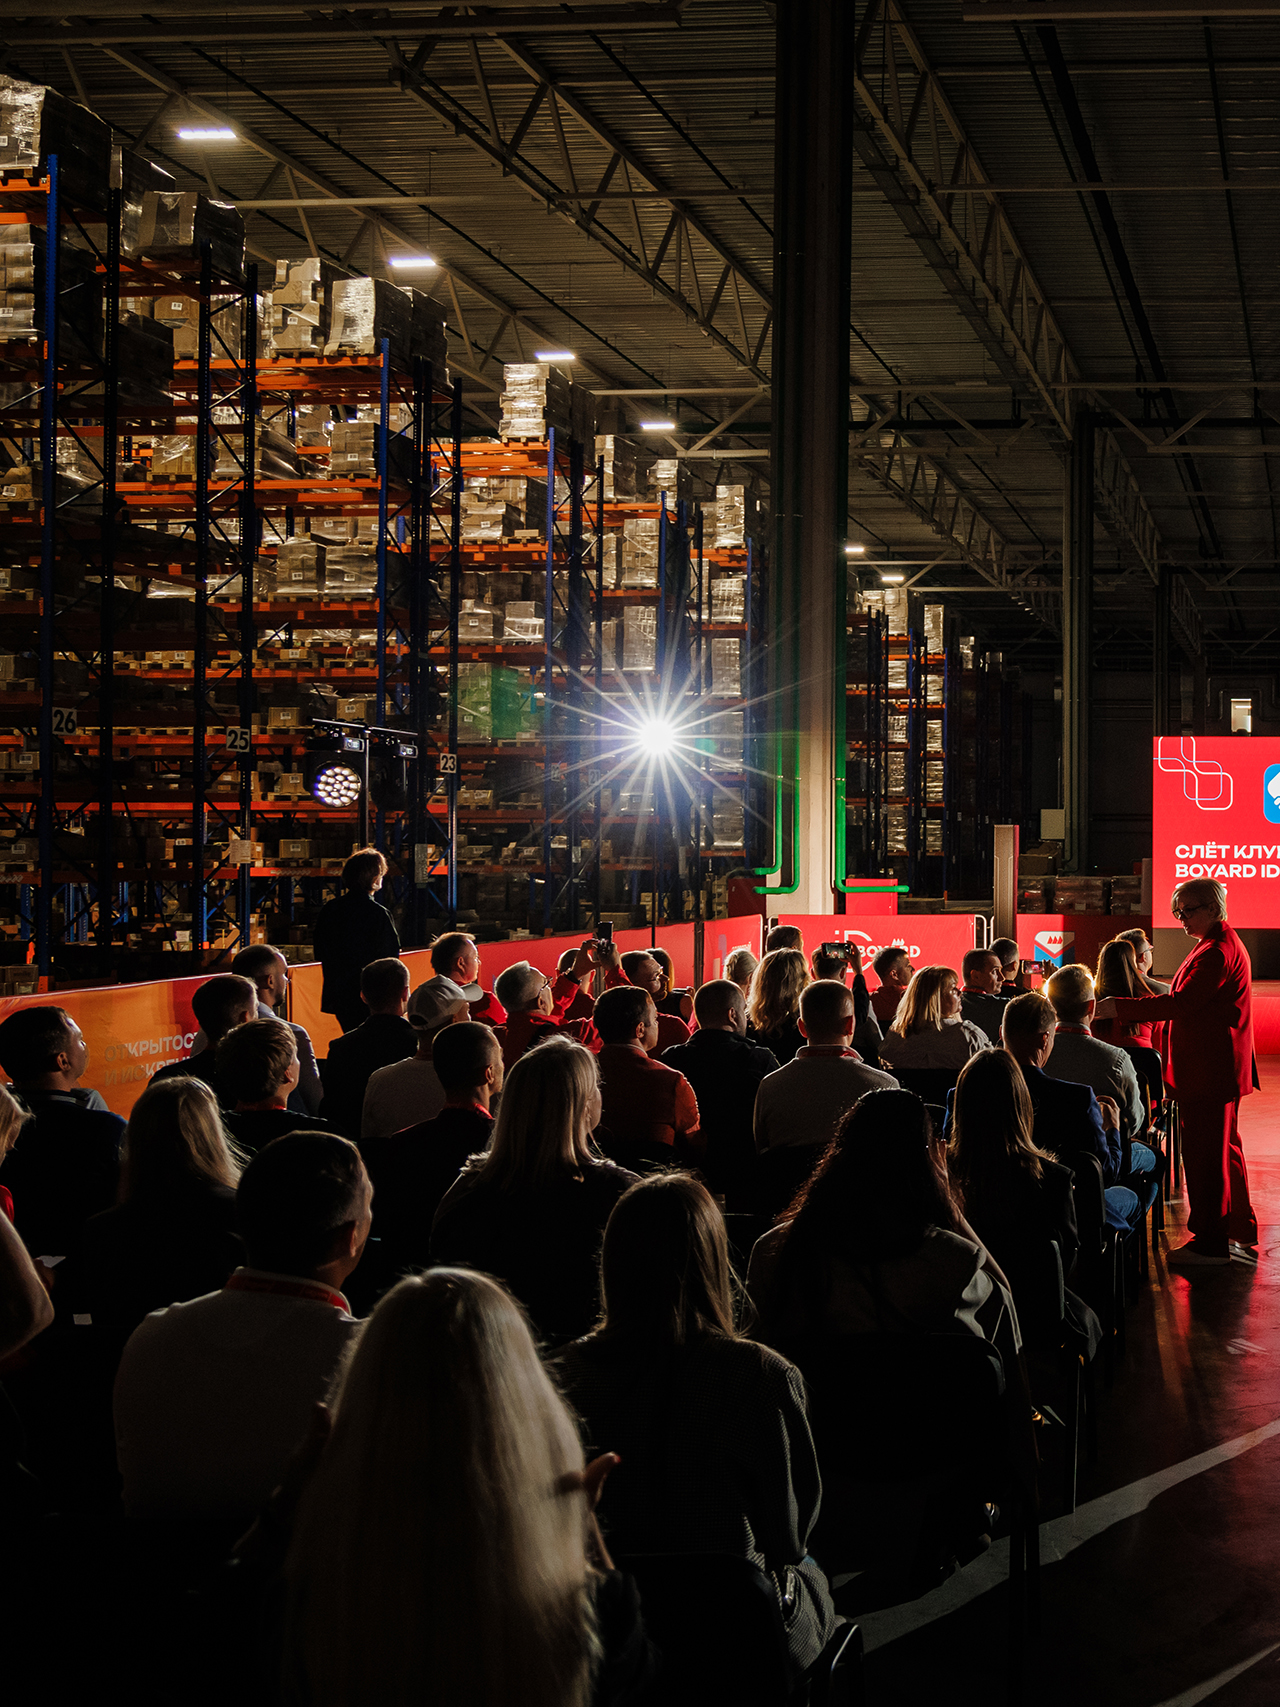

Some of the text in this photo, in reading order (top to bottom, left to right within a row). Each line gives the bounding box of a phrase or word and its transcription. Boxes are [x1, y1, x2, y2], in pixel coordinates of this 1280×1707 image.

[53, 709, 77, 733] 26
[227, 729, 249, 750] 25
[441, 755, 456, 772] 23
[1175, 841, 1230, 859] СЛЁТ
[1175, 863, 1280, 878] BOYARD ID
[104, 1032, 198, 1062] ОТКРЫТОС
